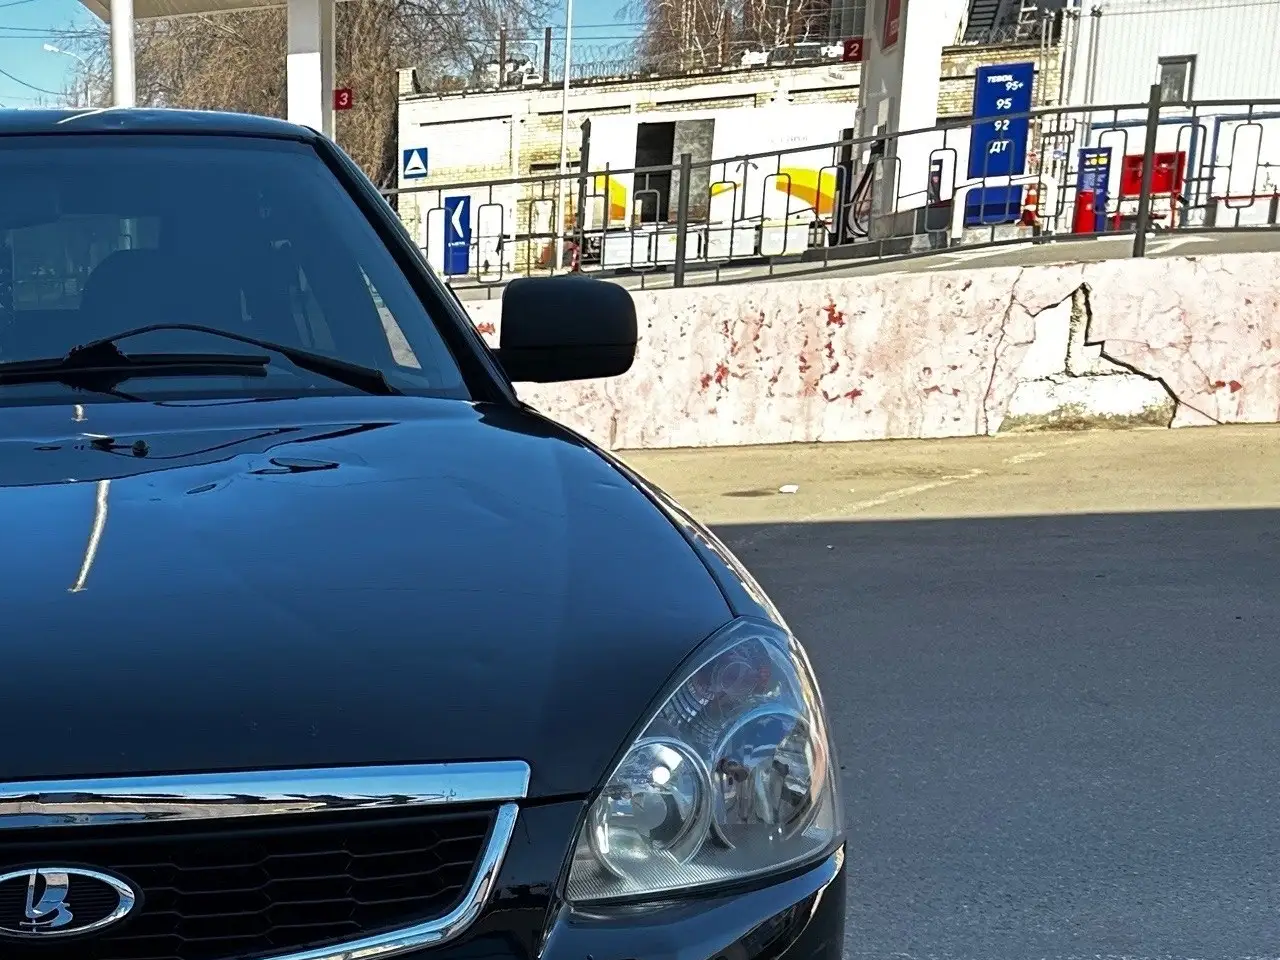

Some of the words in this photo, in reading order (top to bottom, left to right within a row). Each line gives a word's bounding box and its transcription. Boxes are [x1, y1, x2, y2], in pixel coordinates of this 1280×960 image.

[848, 43, 860, 57] 2
[339, 92, 349, 106] 3
[996, 98, 1013, 110] 95
[994, 119, 1010, 132] 92
[989, 140, 1010, 154] ДТ
